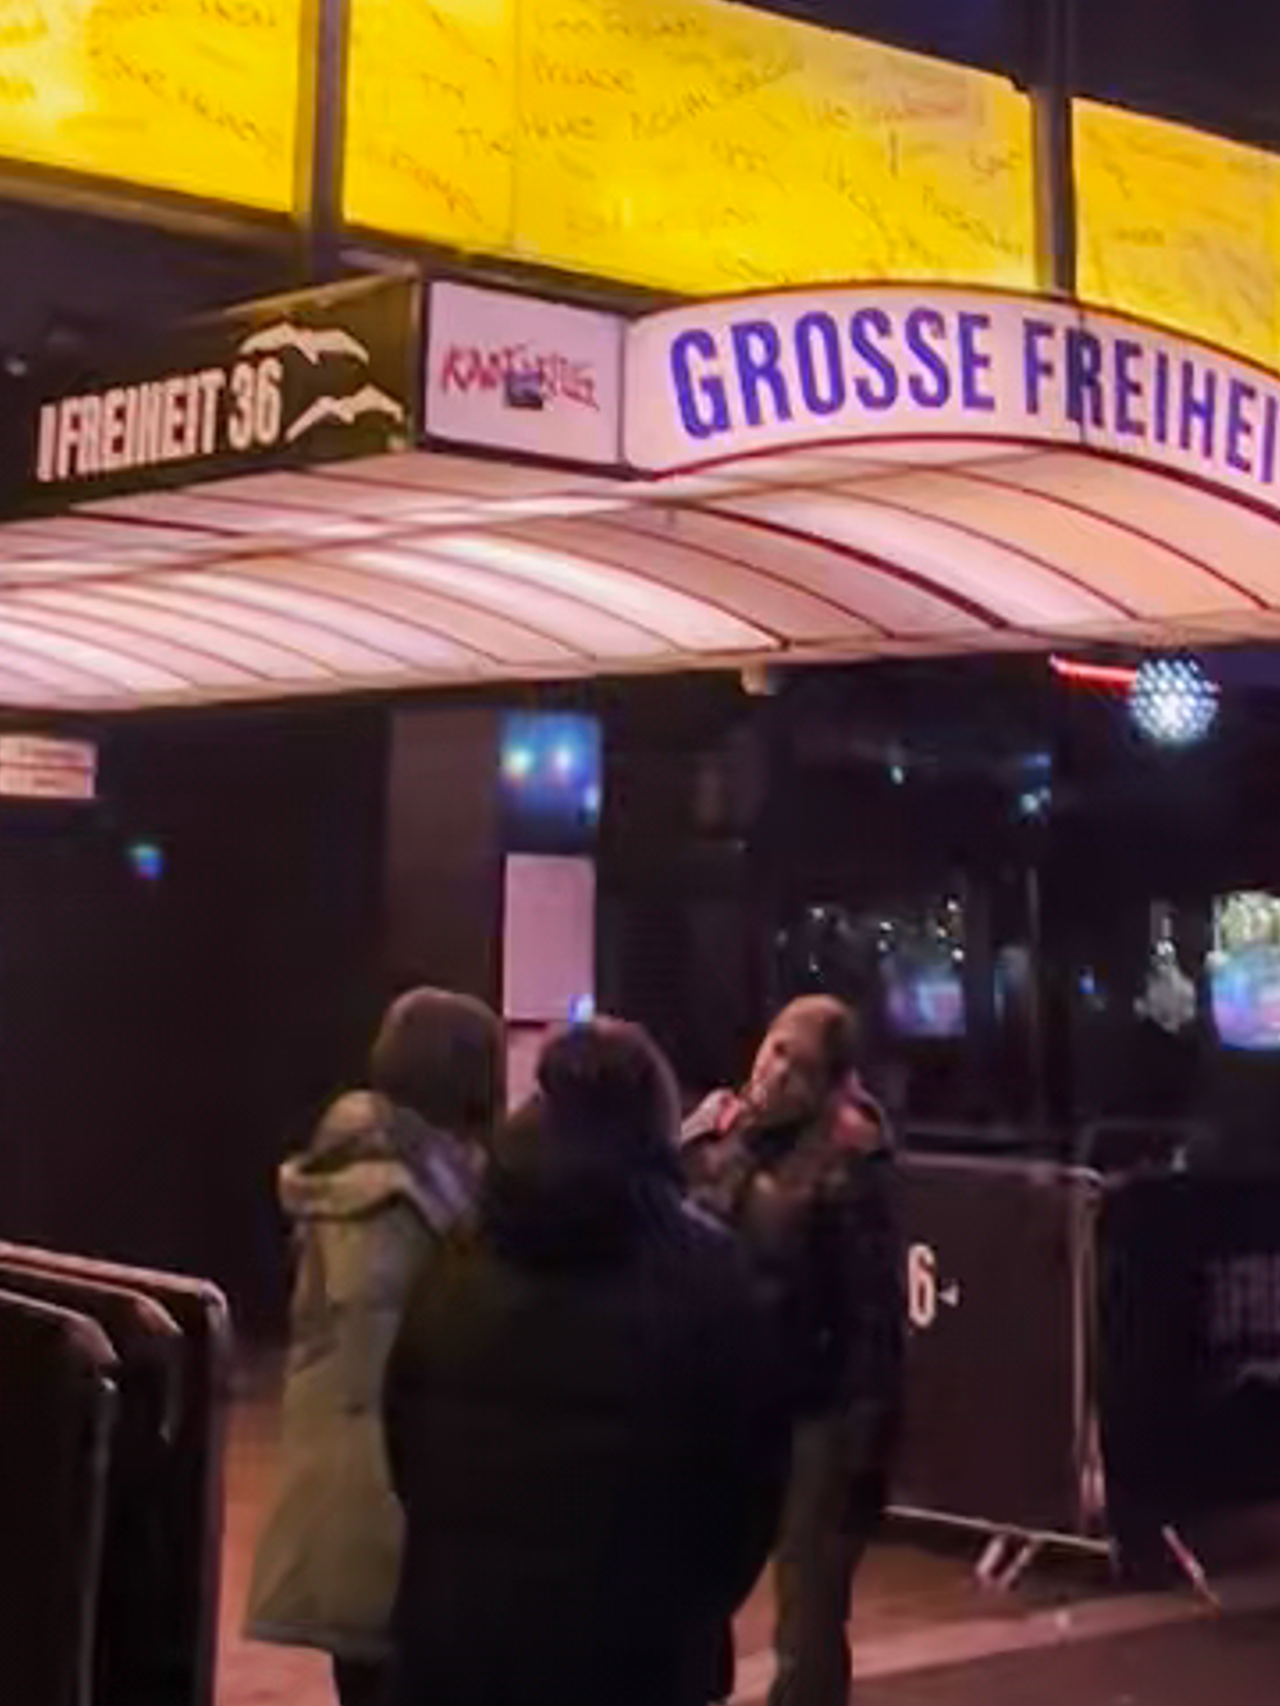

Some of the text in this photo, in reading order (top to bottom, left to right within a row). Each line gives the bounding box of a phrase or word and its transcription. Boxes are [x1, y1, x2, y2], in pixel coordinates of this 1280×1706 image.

[57, 367, 226, 479] FREIHEIT
[228, 357, 283, 451] 36
[670, 307, 997, 440] GROSSE
[908, 1242, 937, 1327] 6
